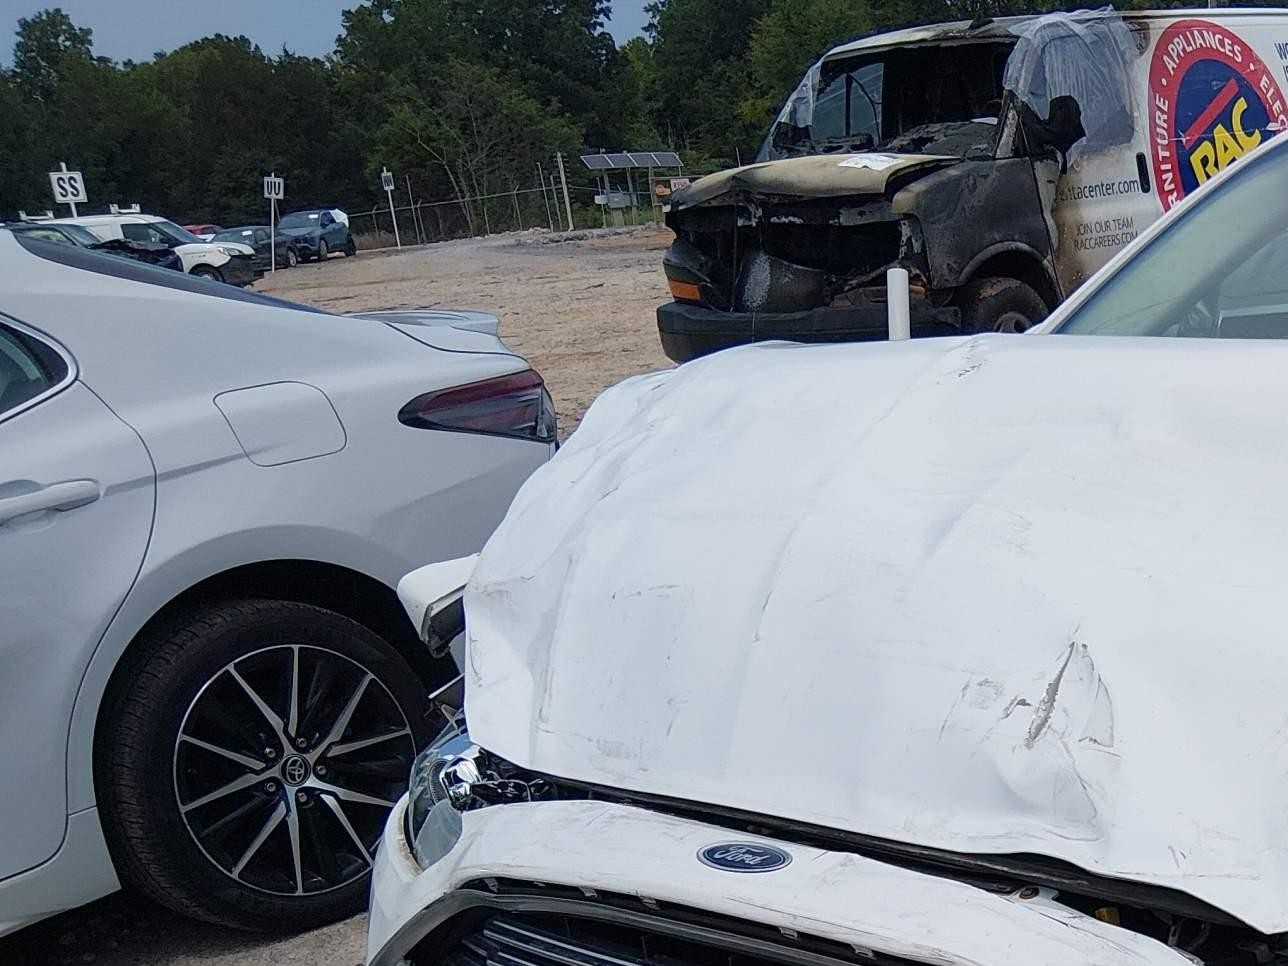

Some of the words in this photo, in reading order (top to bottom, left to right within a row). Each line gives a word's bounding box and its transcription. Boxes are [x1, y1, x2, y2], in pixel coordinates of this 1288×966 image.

[1162, 30, 1243, 75] APPLIANCES
[1260, 74, 1288, 128] ELEC
[1155, 93, 1181, 208] RNITURE
[1189, 96, 1262, 186] RAC
[56, 175, 80, 198] SS
[266, 180, 281, 196] UU
[1057, 179, 1140, 201] entacenter.com
[1076, 222, 1093, 237] JOIN
[1094, 219, 1112, 233] OUR
[1111, 217, 1135, 231] TEAM
[713, 845, 771, 865] Ford
